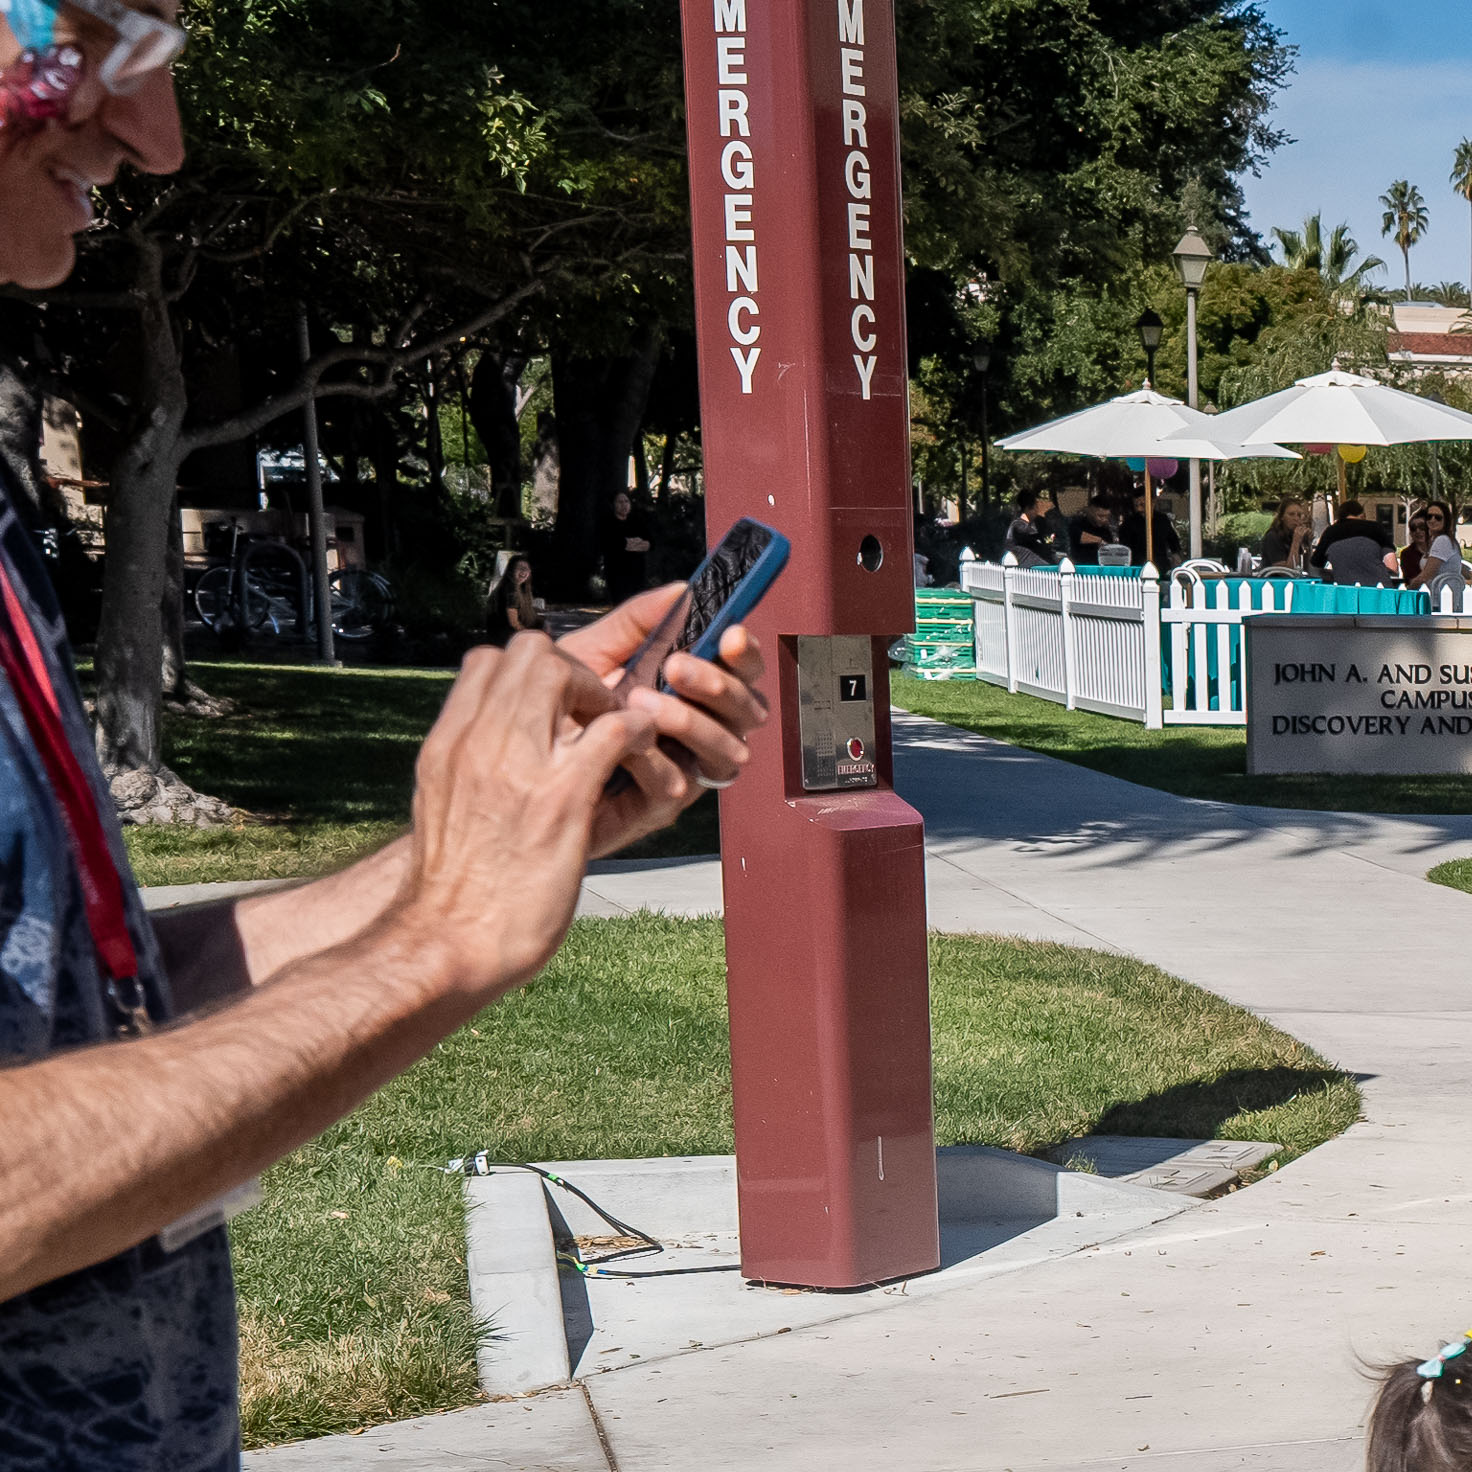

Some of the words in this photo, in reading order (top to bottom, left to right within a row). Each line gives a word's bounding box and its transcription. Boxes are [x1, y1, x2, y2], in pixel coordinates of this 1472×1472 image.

[713, 0, 761, 394] MERGENCY
[837, 0, 877, 400] MERGENCY
[1274, 663, 1336, 685] JOHN
[1345, 664, 1368, 683] A.
[1377, 664, 1432, 684] AND
[849, 680, 857, 697] 7
[1272, 715, 1411, 735] DISCOVERY
